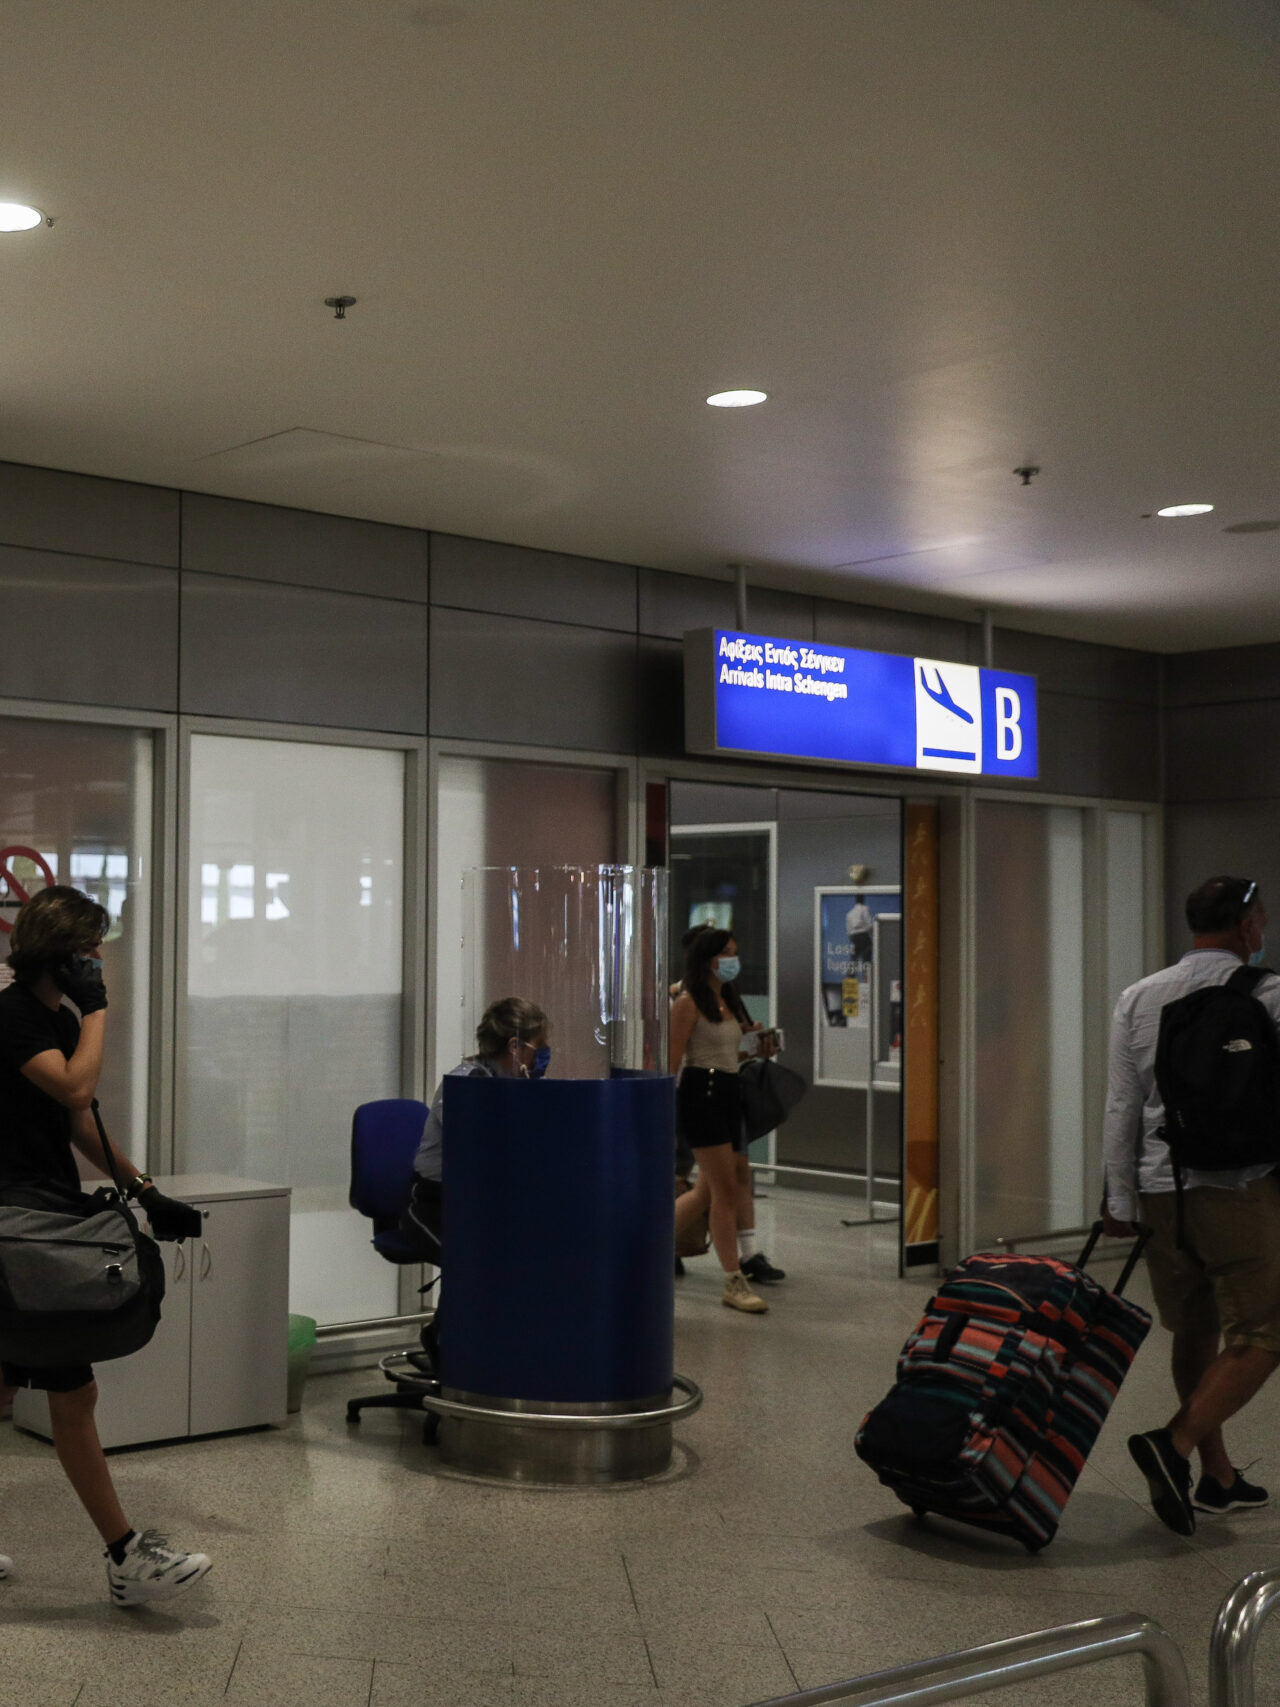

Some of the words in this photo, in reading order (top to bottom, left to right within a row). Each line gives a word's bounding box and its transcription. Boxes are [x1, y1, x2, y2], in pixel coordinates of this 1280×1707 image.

[719, 636, 763, 666] Αφίξεις
[765, 643, 798, 671] Εντός
[800, 648, 845, 674] Σένγκεν
[720, 664, 764, 688] Arrivals
[766, 669, 792, 692] Intra
[794, 673, 848, 701] Schengen
[995, 687, 1023, 761] B
[827, 941, 856, 955] Lost
[827, 958, 872, 976] luggag
